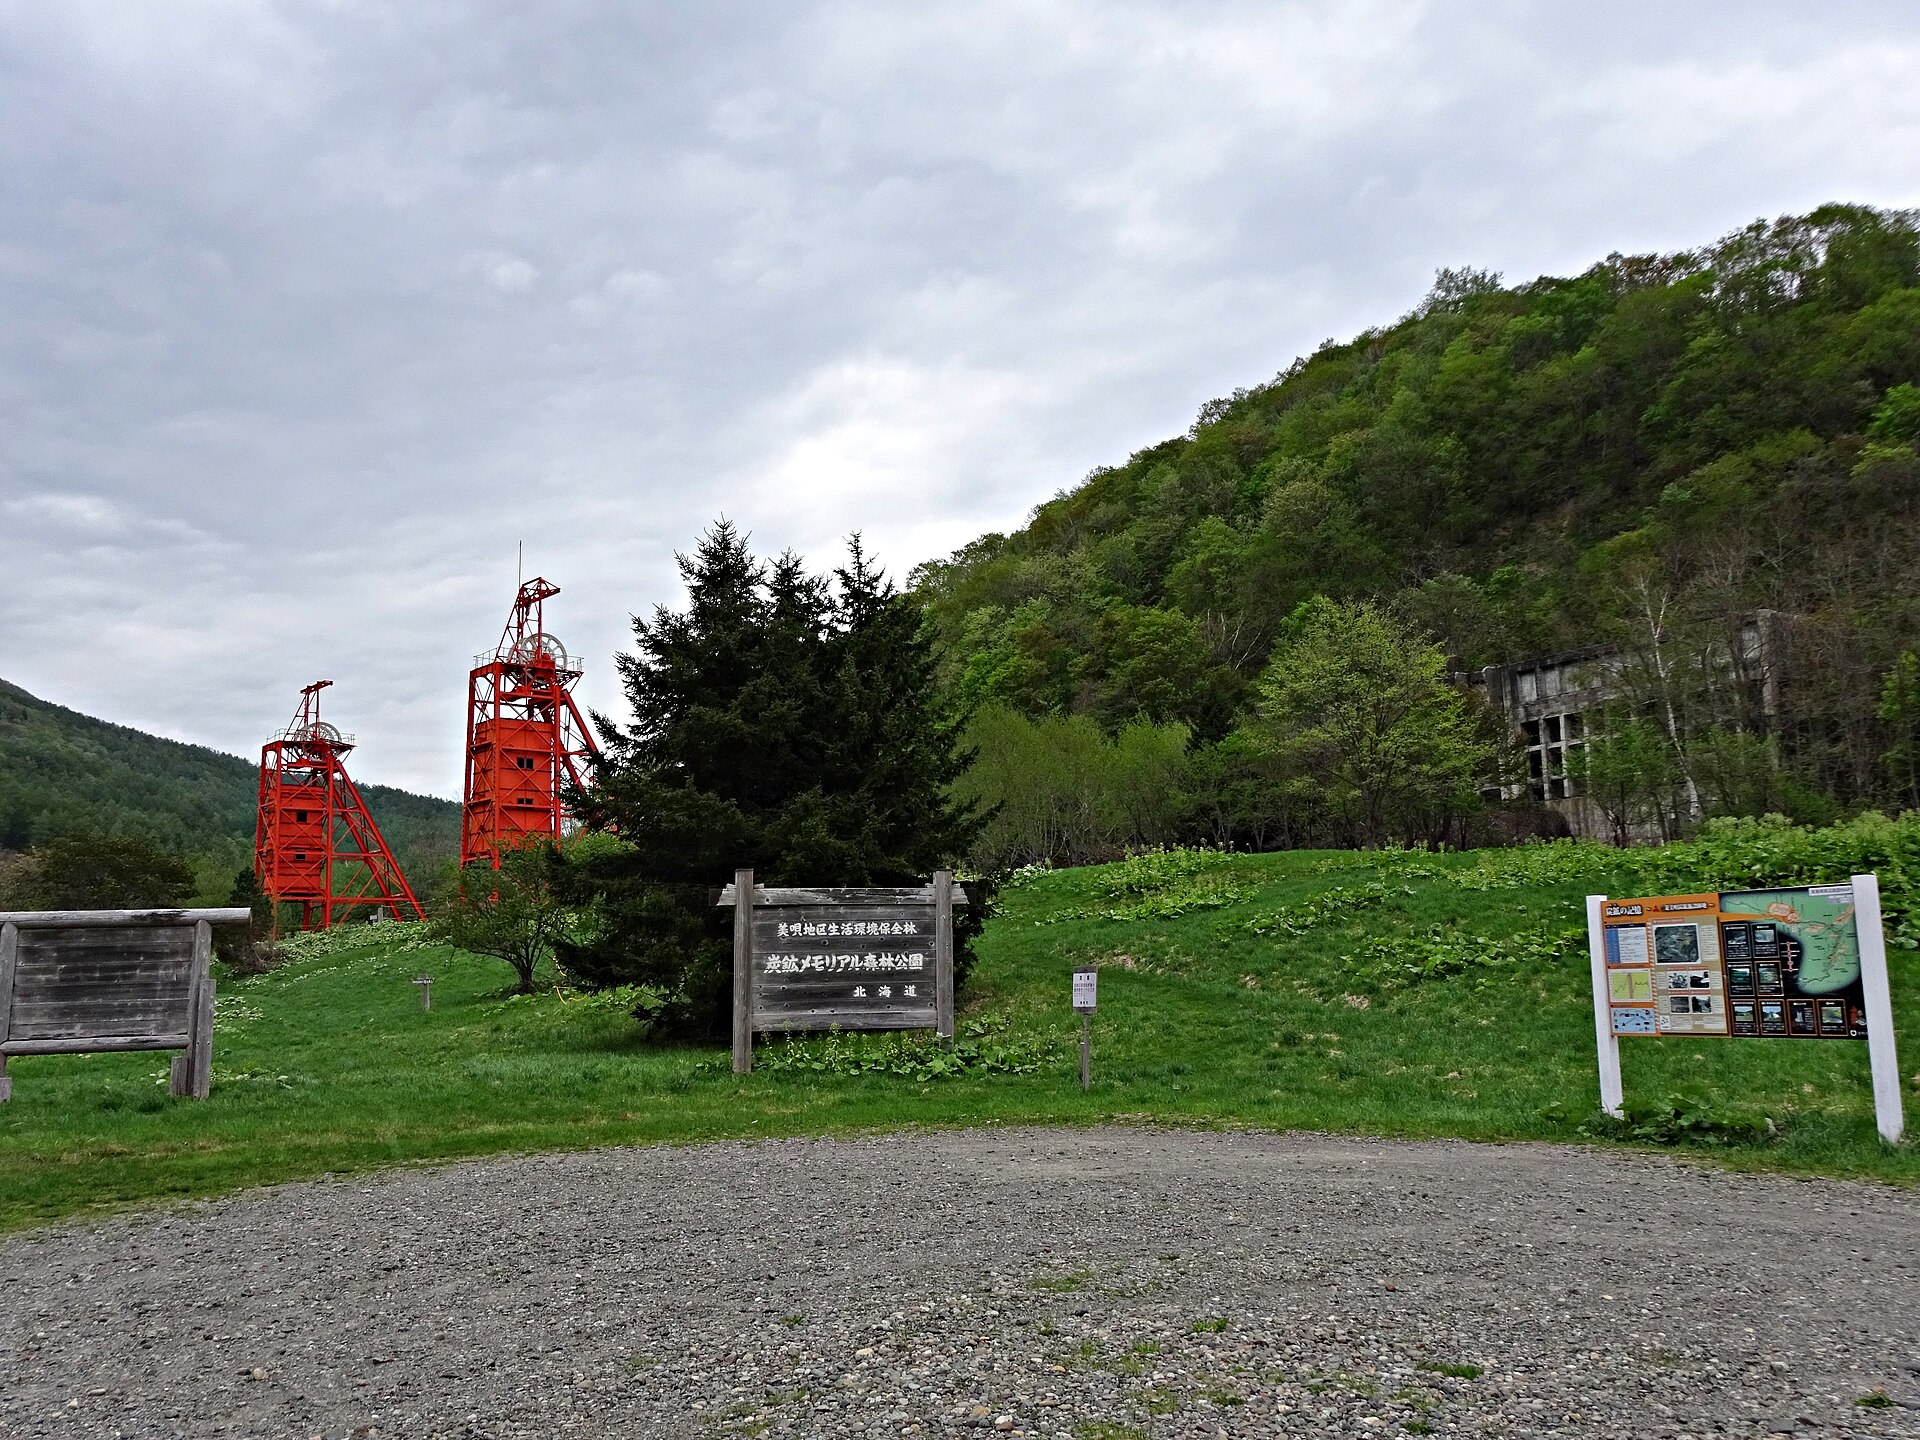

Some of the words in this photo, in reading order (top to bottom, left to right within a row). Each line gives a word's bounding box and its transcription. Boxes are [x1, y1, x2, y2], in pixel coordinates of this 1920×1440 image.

[777, 921, 917, 937] 美唄地区生活環境保全林
[764, 952, 924, 973] 炭鉱メモリアル森林公園
[853, 985, 917, 998] 北海道
